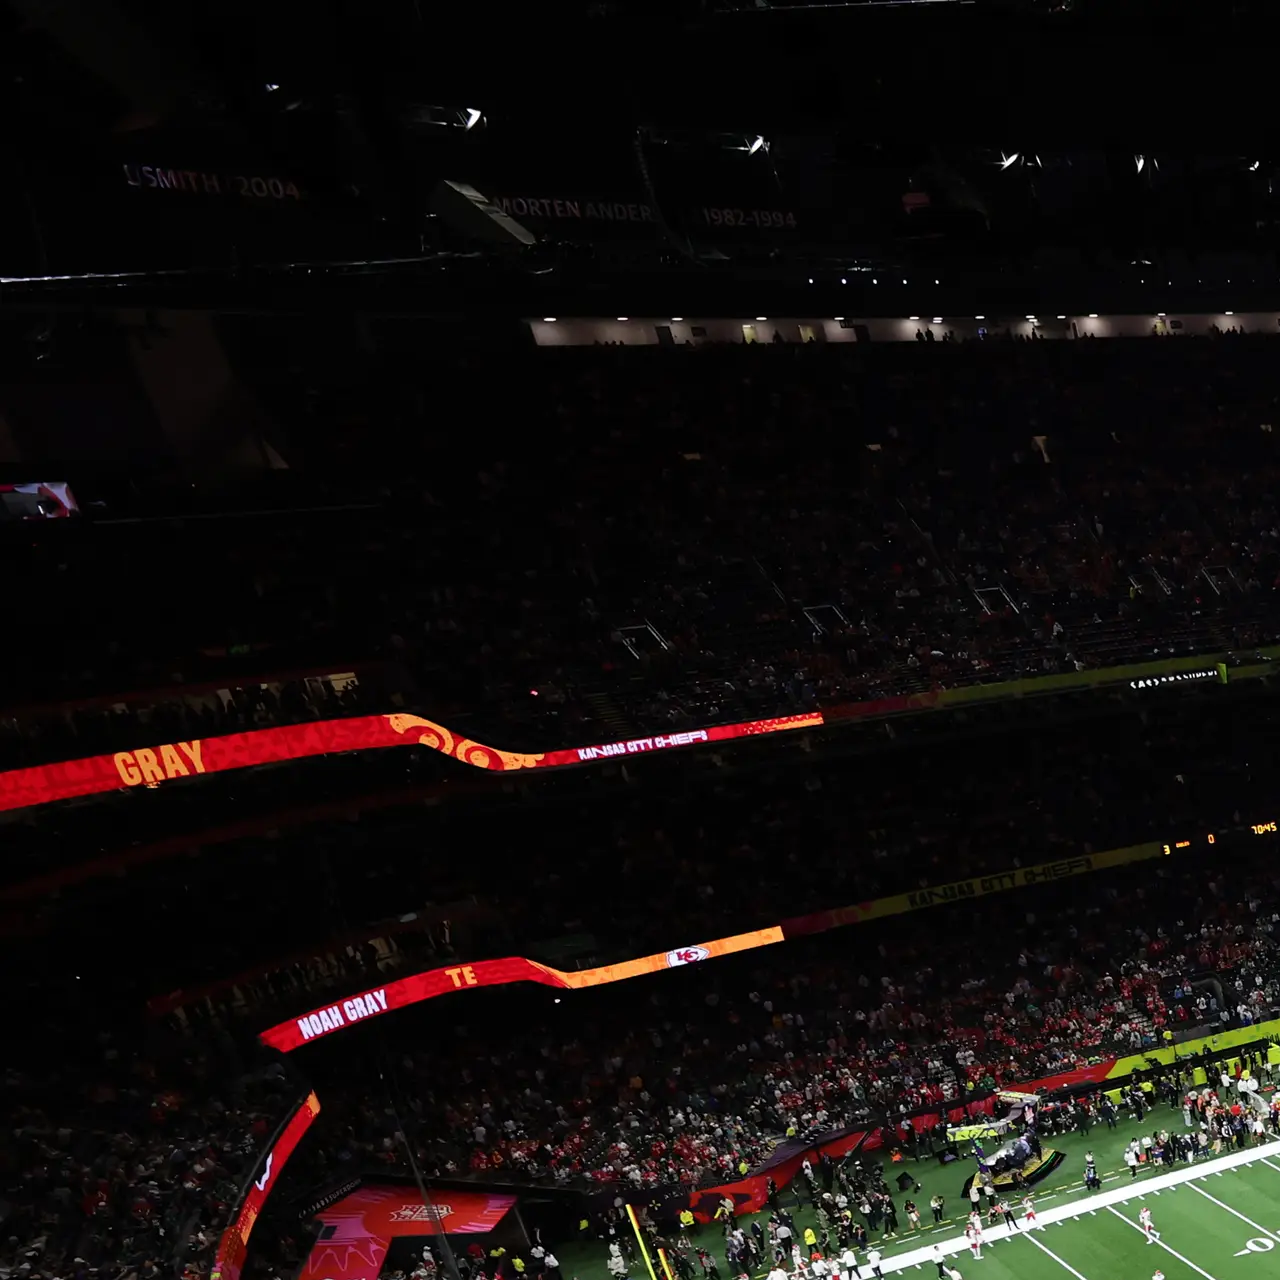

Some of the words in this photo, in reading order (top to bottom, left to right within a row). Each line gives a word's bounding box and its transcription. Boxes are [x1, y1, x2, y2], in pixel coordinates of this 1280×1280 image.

[578, 743, 626, 761] KANSAS
[627, 738, 654, 754] CITY
[656, 730, 708, 748] CHIEFS
[114, 740, 206, 788] GRAY
[1251, 821, 1277, 835] 70:45
[445, 966, 478, 988] TE
[297, 1004, 345, 1040] NOAH
[343, 989, 389, 1022] GRAY
